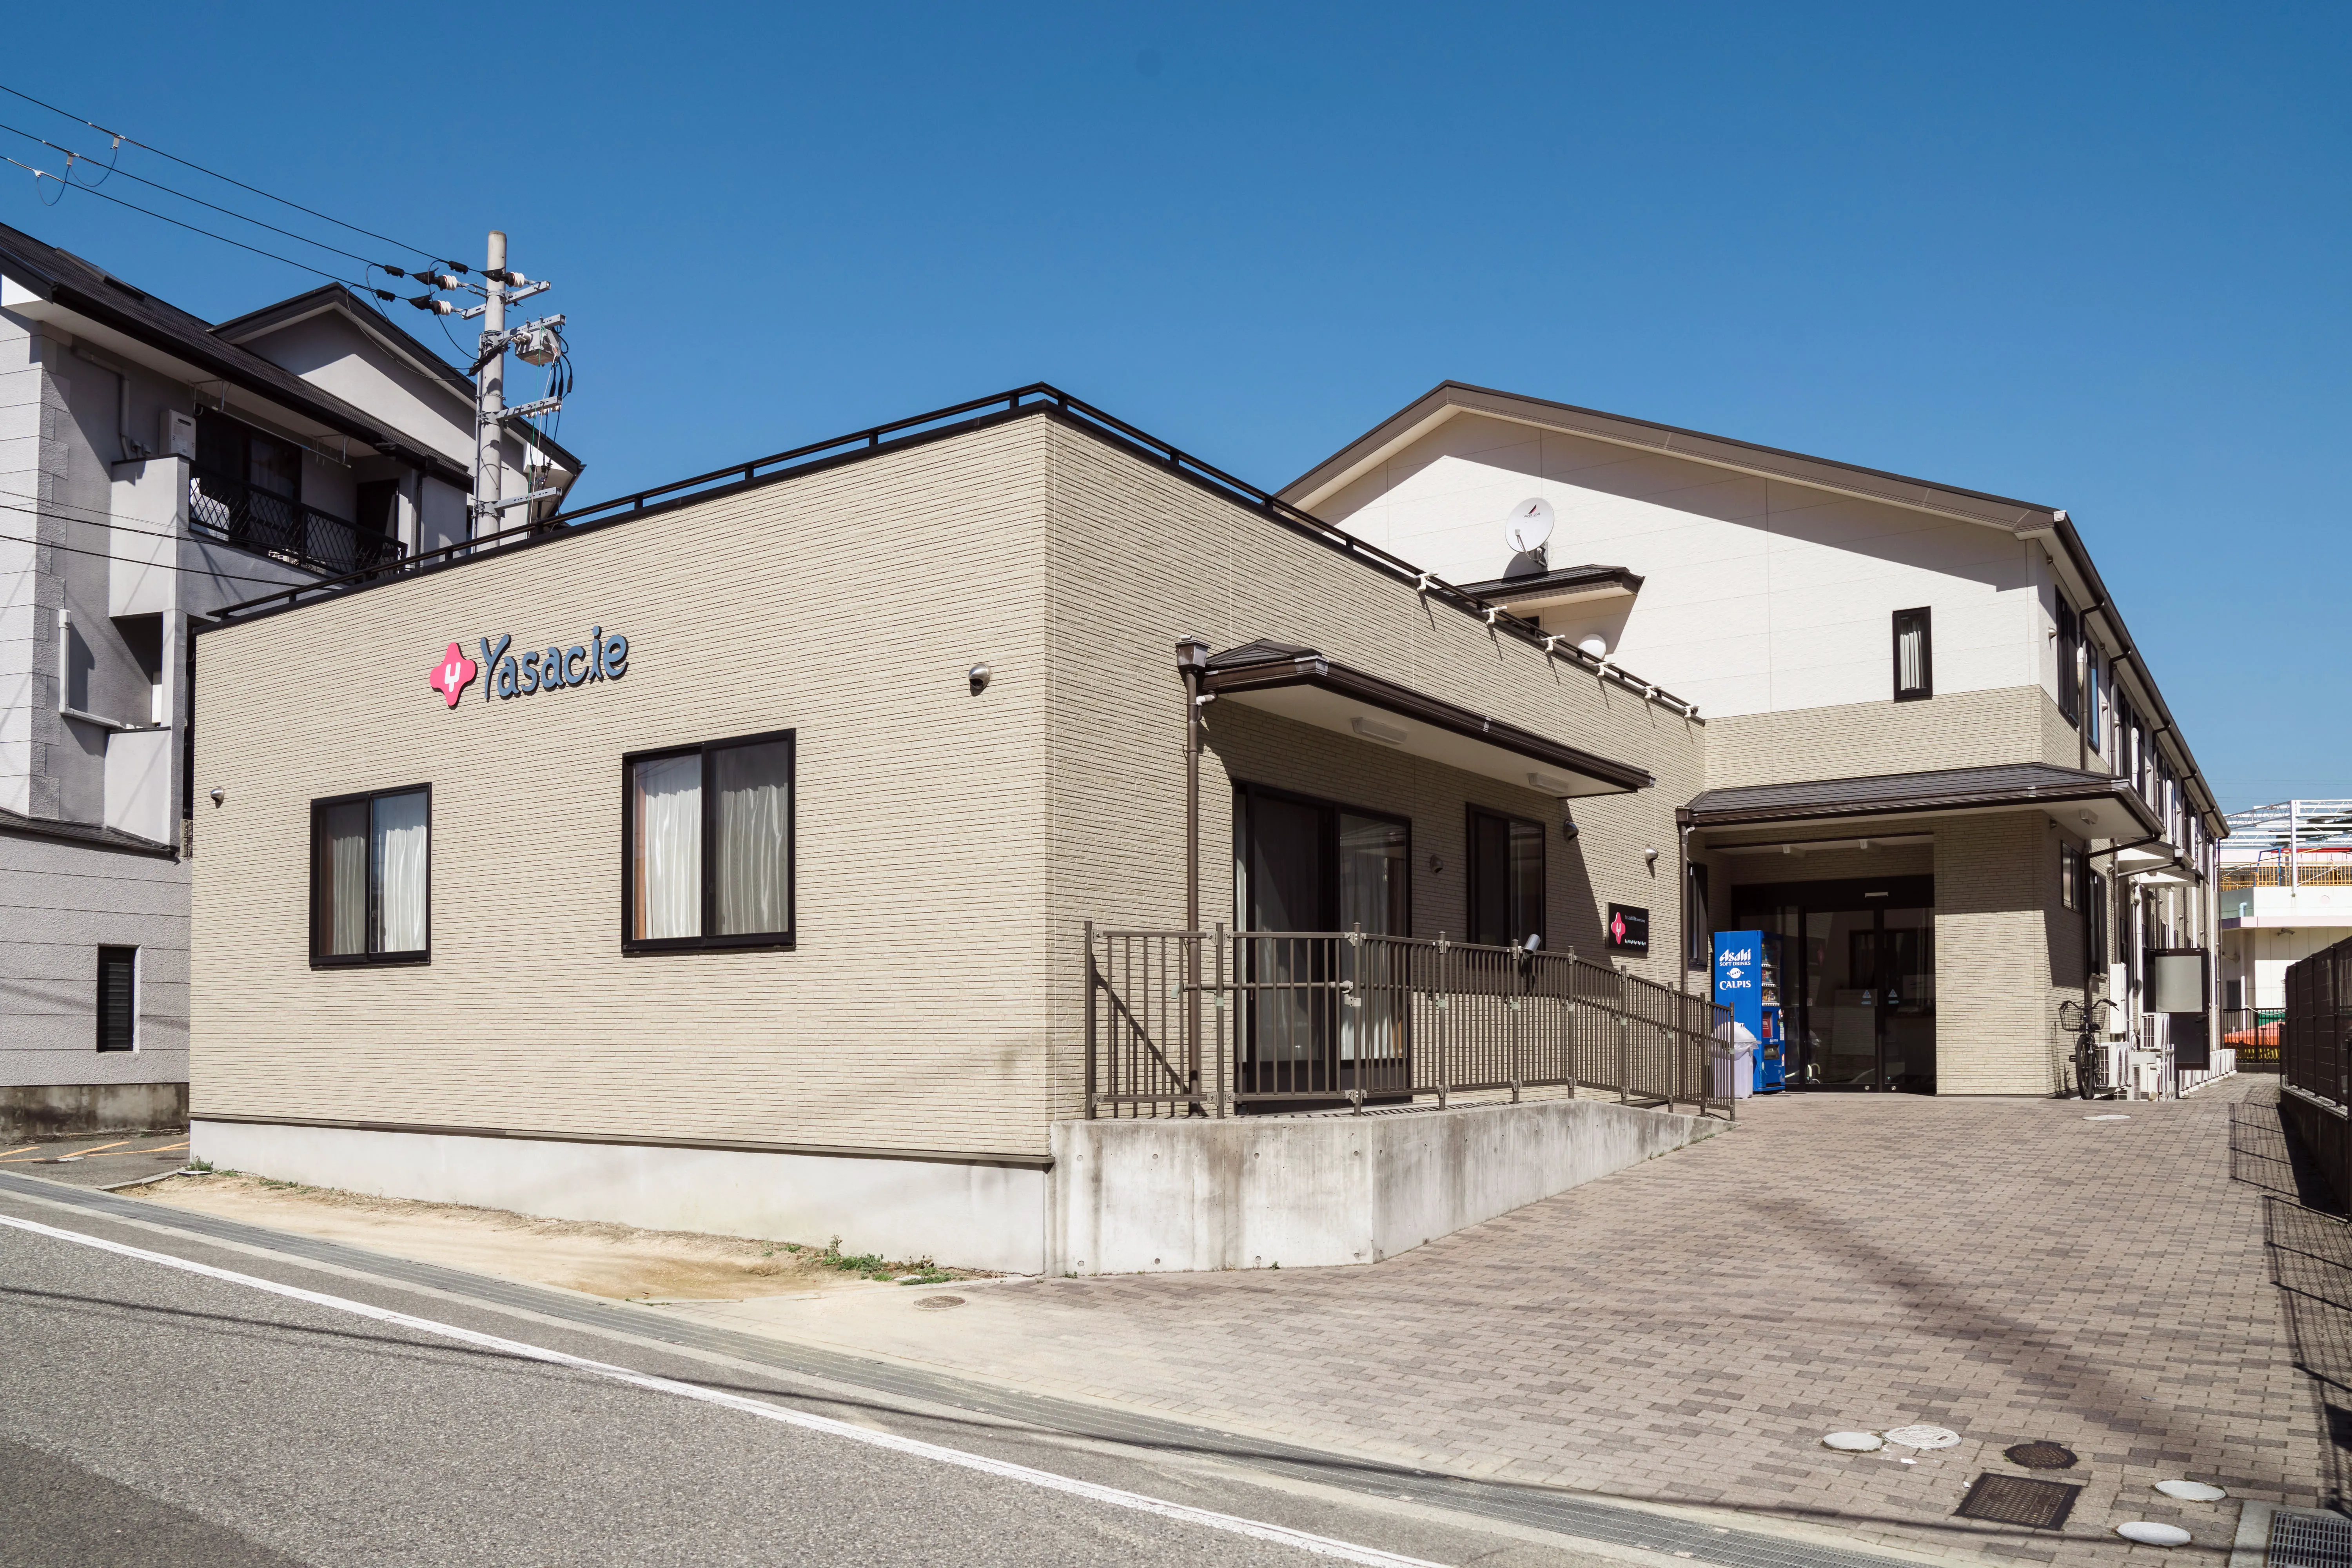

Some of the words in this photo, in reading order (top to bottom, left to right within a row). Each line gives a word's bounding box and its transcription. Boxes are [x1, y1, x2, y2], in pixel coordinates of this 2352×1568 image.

[480, 625, 628, 701] Yasacie
[1719, 948, 1751, 962] Asahi
[1719, 980, 1751, 990] CALPIS
